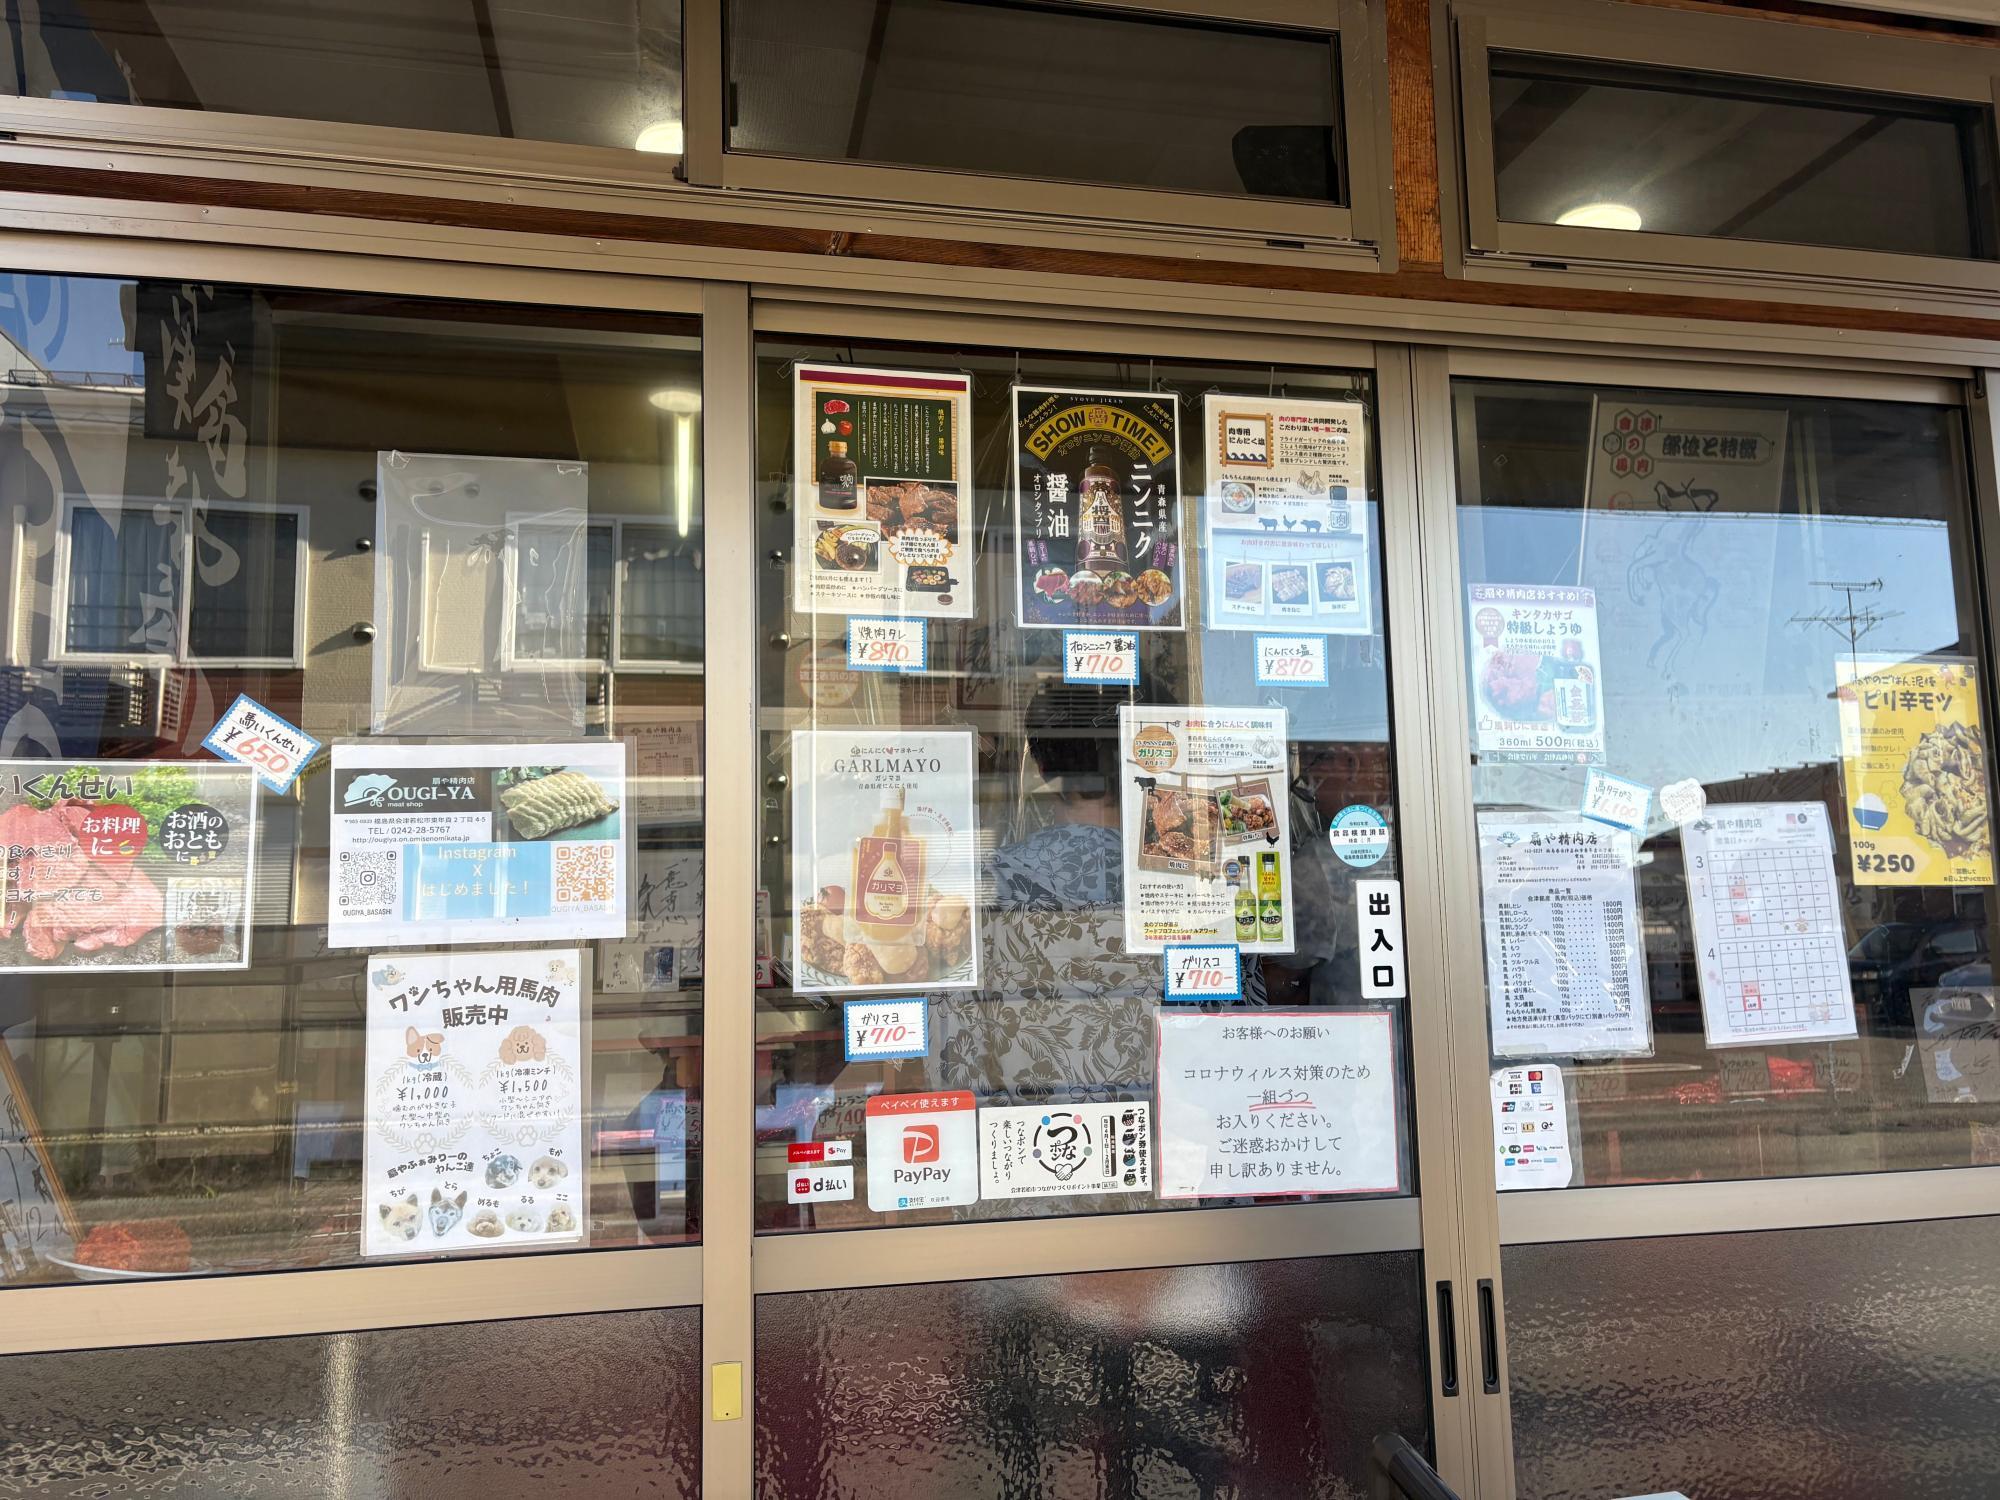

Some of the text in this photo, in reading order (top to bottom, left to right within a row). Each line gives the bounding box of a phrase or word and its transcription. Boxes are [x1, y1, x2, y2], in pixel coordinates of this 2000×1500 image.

[1278, 415, 1348, 426] 肉の専門家と共同開発した
[1032, 410, 1086, 452] SHOW
[1110, 412, 1166, 458] TIME!
[1228, 427, 1251, 437] 肉専用
[1228, 437, 1266, 446] にんにく塩
[1628, 436, 1640, 451] の
[1662, 434, 1758, 460] 部位と特徴
[1046, 473, 1070, 539] 醤油
[1130, 464, 1154, 560] ニンニク
[1156, 484, 1168, 533] 青森県産
[1512, 609, 1573, 620] キンタカサゴ
[857, 626, 906, 641] 焼肉タレ
[1506, 622, 1582, 636] 特級しょうゆ
[858, 642, 909, 662] ¥870
[1264, 644, 1314, 657] にんにく塩
[1073, 653, 1124, 674] ¥710
[1265, 658, 1314, 676] ¥870
[1864, 690, 1953, 712] ピリ辛モツ
[1185, 720, 1273, 729] お肉に合うにんにく調味料
[239, 710, 302, 756] 馬いくんせい
[1499, 737, 1532, 747] 360ml
[223, 726, 290, 775] ¥650
[861, 746, 925, 755] にんにく マヨネーズ
[1138, 749, 1173, 758] ガリスコ
[834, 758, 942, 773] GARLMAYO
[431, 777, 475, 785] 扇や精肉店
[387, 786, 476, 801] OUGI-YA
[82, 816, 141, 835] お料理
[167, 810, 223, 831] お酒の
[1716, 818, 1762, 830] 扇や精肉店
[368, 826, 451, 835] TEL 0242-28-5767
[163, 830, 223, 850] おとも
[1529, 831, 1598, 846] 扇や精肉店
[1853, 840, 1876, 851] 100g
[91, 838, 114, 856] に
[438, 846, 517, 861] Instagram
[175, 850, 189, 863] に
[1695, 855, 1704, 869] 3
[1856, 854, 1916, 873] ¥250
[472, 864, 483, 877] X
[422, 880, 529, 897] はじめました！
[872, 882, 903, 893] ガリマヨ
[343, 908, 393, 917] OUGIYA_BASASHI
[1368, 892, 1395, 988] 出入口
[1707, 947, 1716, 961] 4
[1181, 956, 1221, 971] ガリスコ
[388, 975, 561, 1012] ワンちゃん用馬肉
[442, 1004, 509, 1029] 販売中
[860, 1013, 900, 1025] ガリマヨ
[1221, 1025, 1330, 1041] お客様へのお願い
[1183, 1064, 1371, 1081] コロナウィルス対策のため
[396, 1086, 449, 1101] ¥1,000
[499, 1079, 548, 1094] ¥1,500
[880, 1096, 960, 1111] ペイペイ使えます
[1246, 1089, 1310, 1105] 一組づつ
[392, 1100, 456, 1112] 噛むのが好きな子
[500, 1101, 551, 1112] ワンちゃん向き
[399, 1118, 451, 1129] ワンちゃん向き
[1216, 1113, 1334, 1130] お入りください。
[1002, 1119, 1013, 1181] 楽しいつながり
[1016, 1120, 1026, 1165] つなポンで
[1137, 1107, 1148, 1187] つなポン券使えます。
[1218, 1136, 1343, 1155] ご迷惑おかけして
[481, 1147, 502, 1162] ちょこ
[549, 1147, 563, 1158] もか
[387, 1151, 468, 1179] 扇やふぁみりーの
[435, 1161, 475, 1175] わんこ達
[1210, 1160, 1343, 1180] 申し訳ありません。
[893, 1167, 951, 1185] PayPay
[389, 1186, 407, 1198] ちび
[444, 1180, 458, 1191] とら
[813, 1177, 847, 1192] d払い
[520, 1195, 535, 1205] るる
[556, 1193, 569, 1202] ここ
